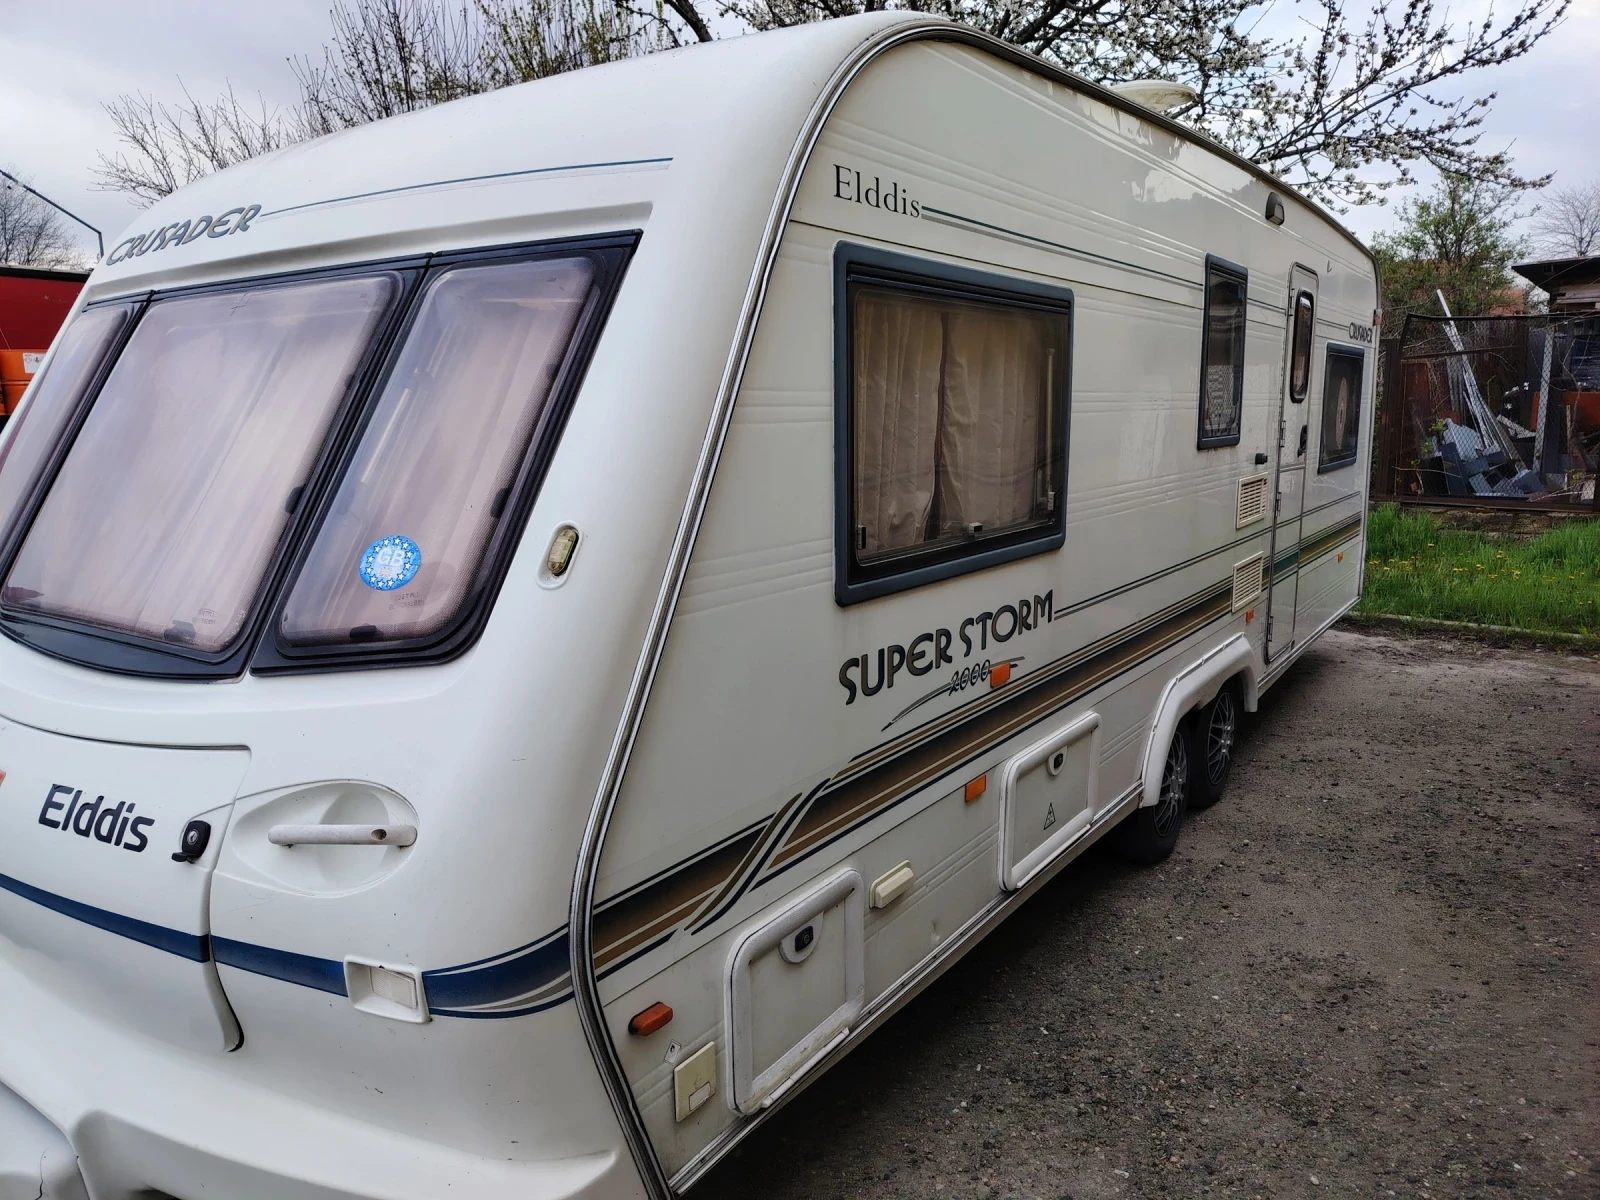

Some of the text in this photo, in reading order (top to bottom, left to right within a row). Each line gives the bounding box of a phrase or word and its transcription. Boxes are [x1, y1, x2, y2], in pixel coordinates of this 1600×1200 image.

[833, 163, 920, 218] Elddis
[105, 204, 262, 266] CRUSADER
[379, 548, 405, 566] GB
[949, 659, 991, 696] 2000
[38, 783, 155, 852] Elddis
